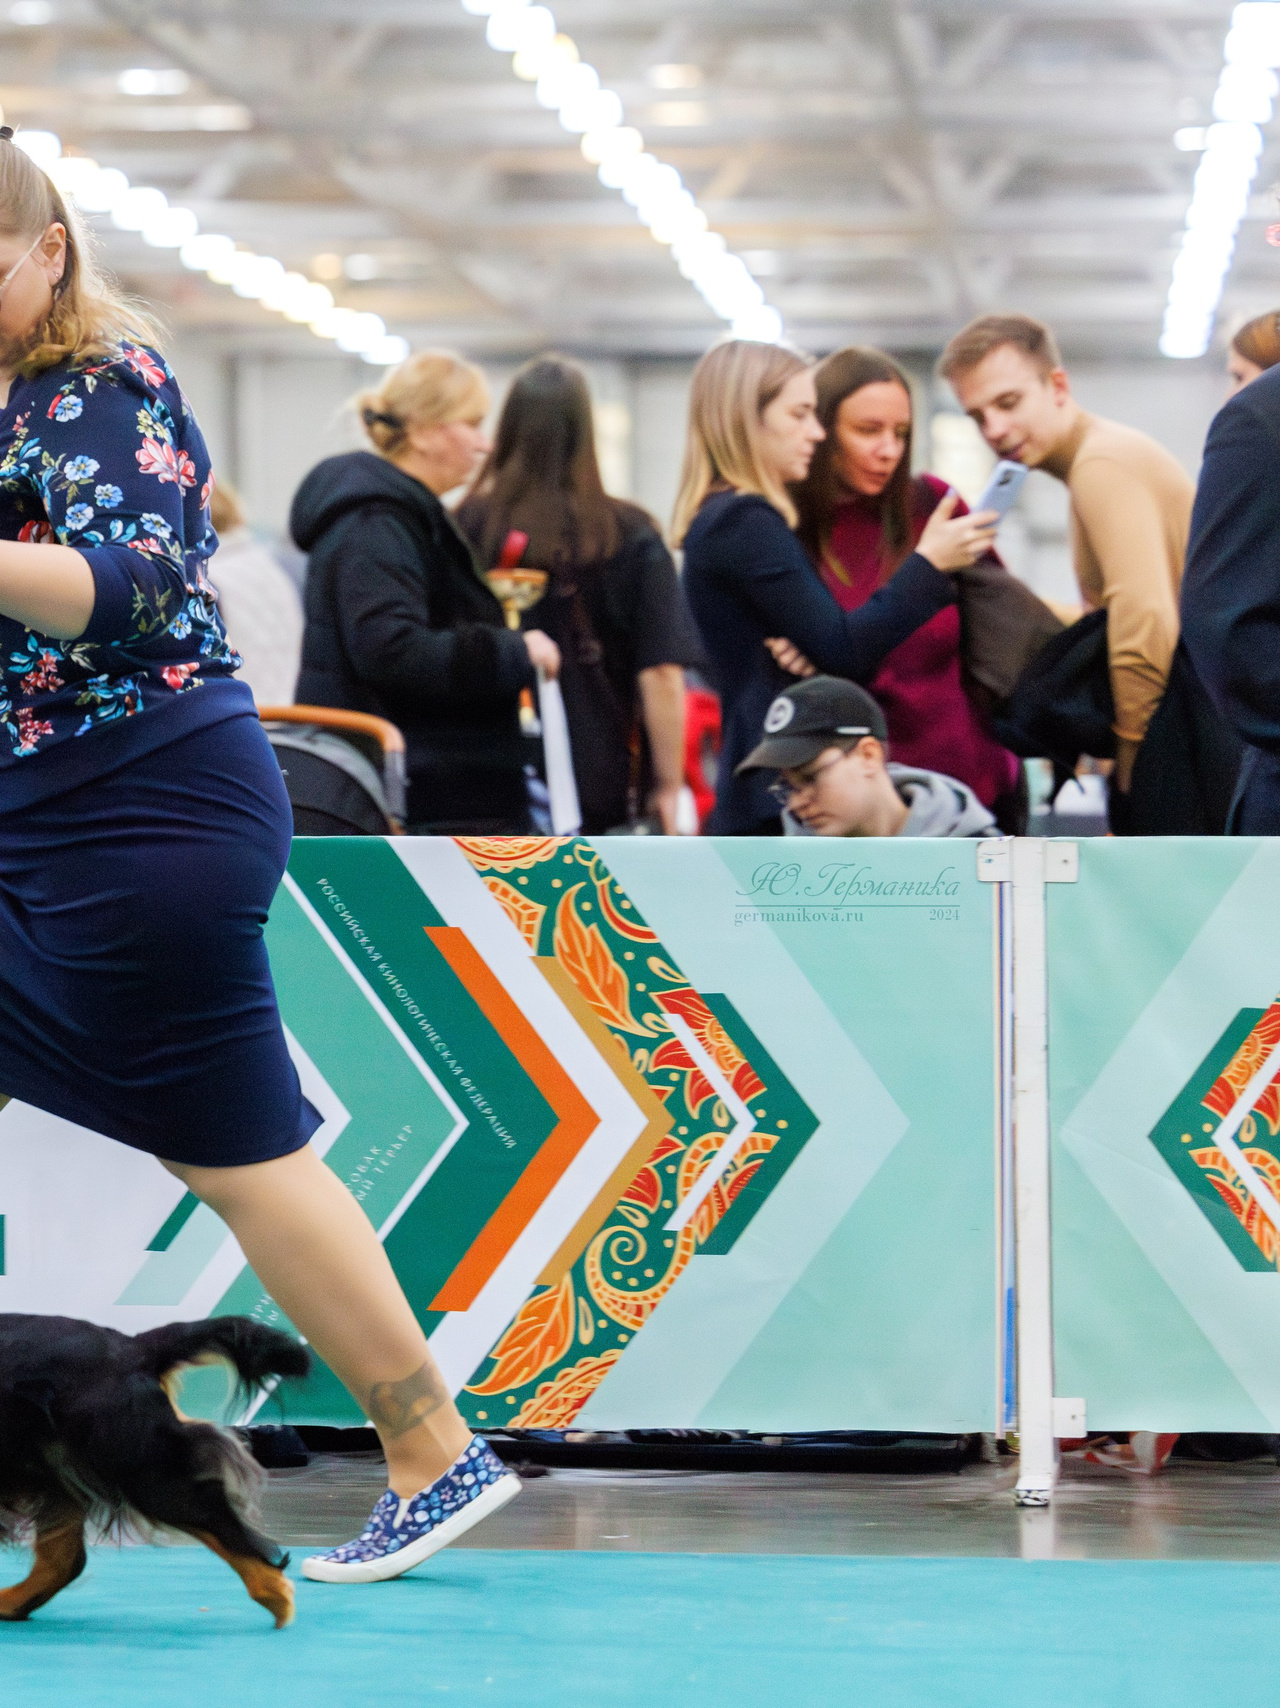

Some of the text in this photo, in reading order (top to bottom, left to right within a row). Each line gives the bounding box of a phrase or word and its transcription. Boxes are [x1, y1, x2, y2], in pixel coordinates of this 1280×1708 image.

[316, 878, 517, 1149] РОССИЙСКАЯ КИНОЛОГИЧЕСКАЯ ФЕДЕРАЦИЯ
